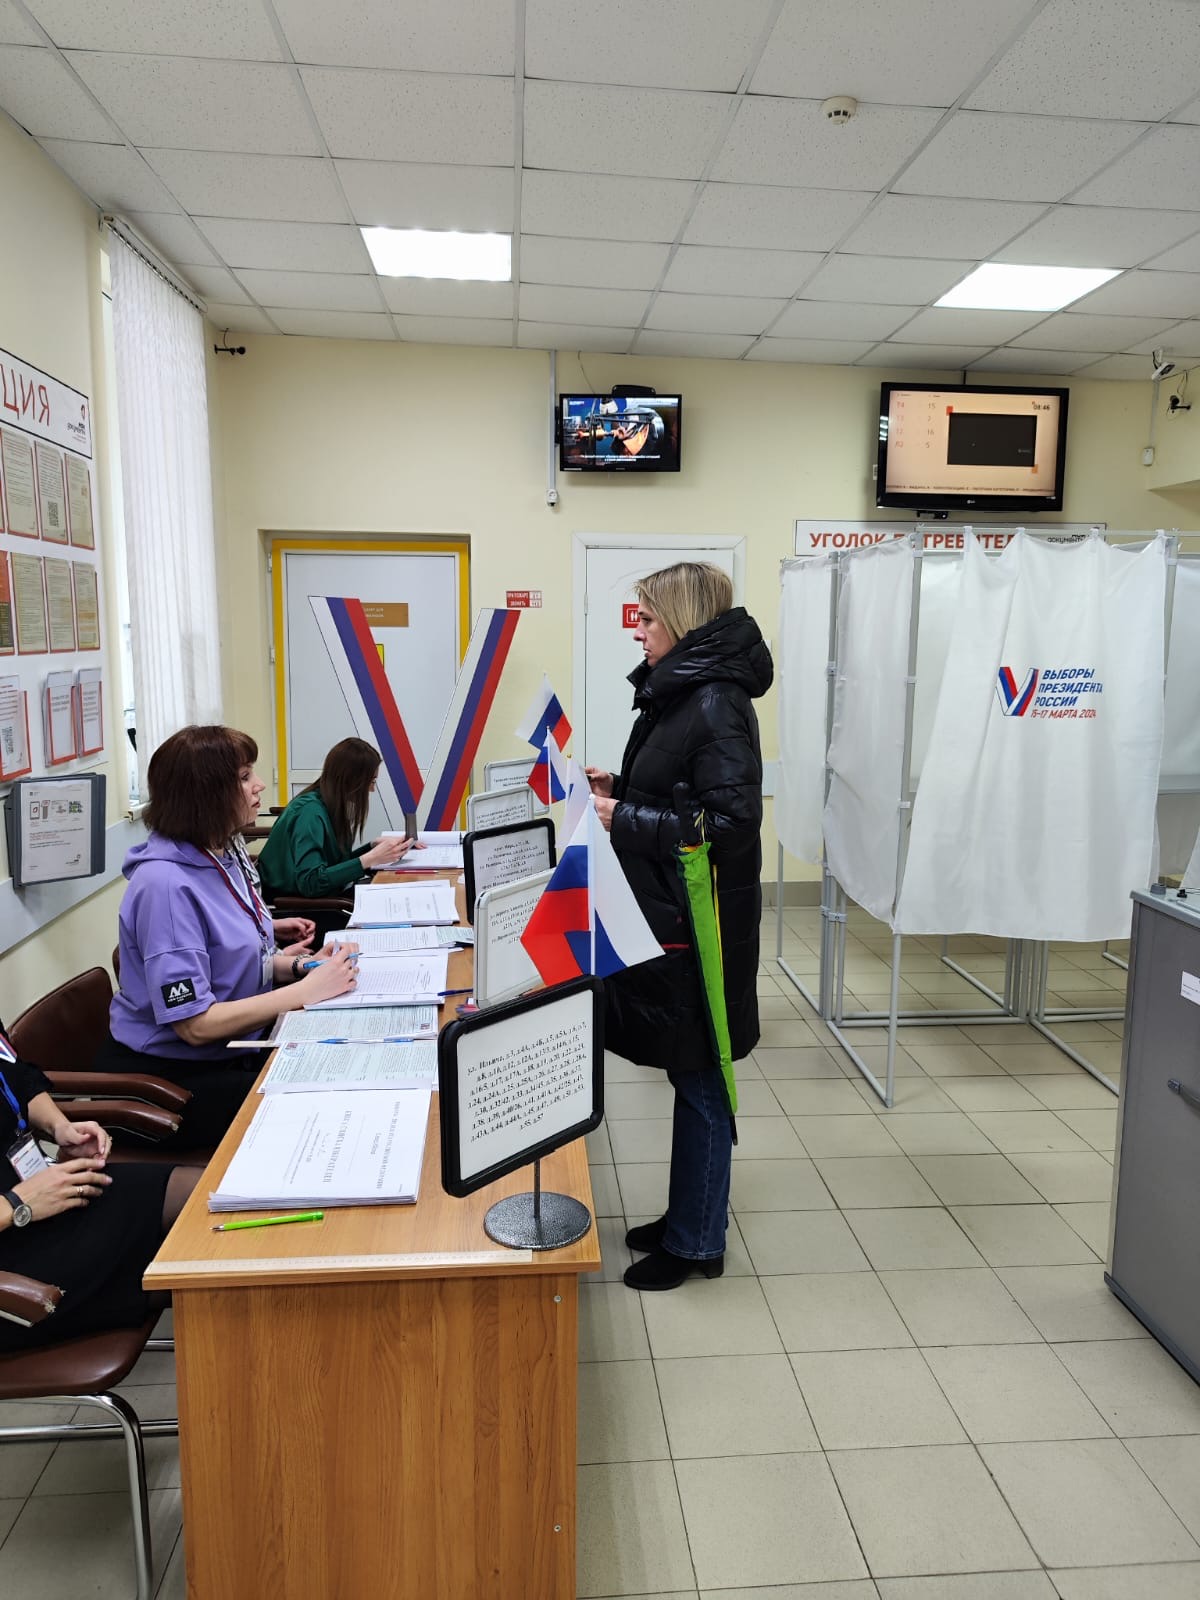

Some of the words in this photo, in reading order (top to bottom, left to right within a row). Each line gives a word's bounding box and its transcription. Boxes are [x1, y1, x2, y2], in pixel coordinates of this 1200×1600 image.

[1042, 668, 1096, 680] ВЫБОРЫ
[1034, 695, 1079, 707] РОССИИ
[1049, 708, 1078, 719] МАРТА
